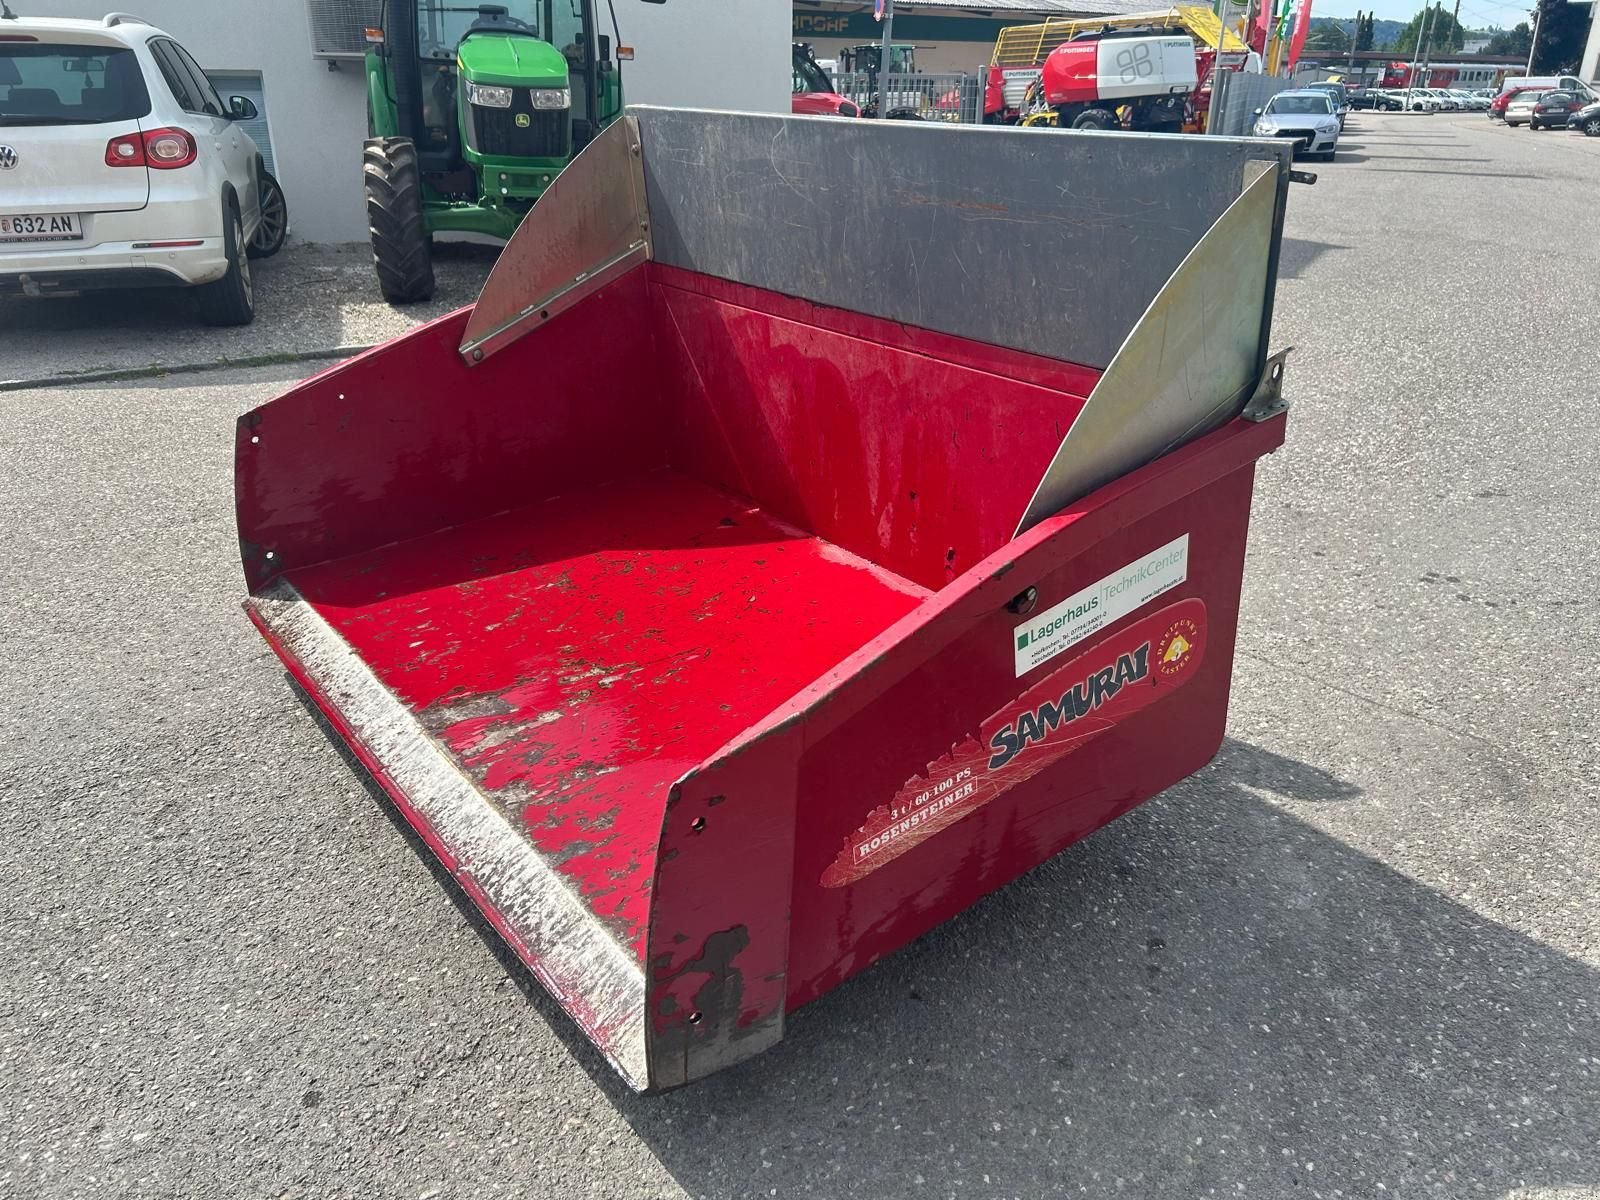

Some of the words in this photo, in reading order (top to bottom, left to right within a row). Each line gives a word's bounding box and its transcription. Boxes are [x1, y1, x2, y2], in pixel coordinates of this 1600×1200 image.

[12, 216, 46, 233] 632
[50, 215, 73, 232] AN
[1030, 595, 1099, 643] Lagerhaus
[1103, 547, 1185, 602] TechnikCenter
[1160, 655, 1190, 675] LASTER
[988, 641, 1150, 770] SAMURAI
[859, 782, 974, 857] ROSENSTEINER
[891, 809, 898, 820] 3
[901, 805, 906, 814] t
[915, 778, 953, 806] 60-100
[956, 767, 971, 782] PS
